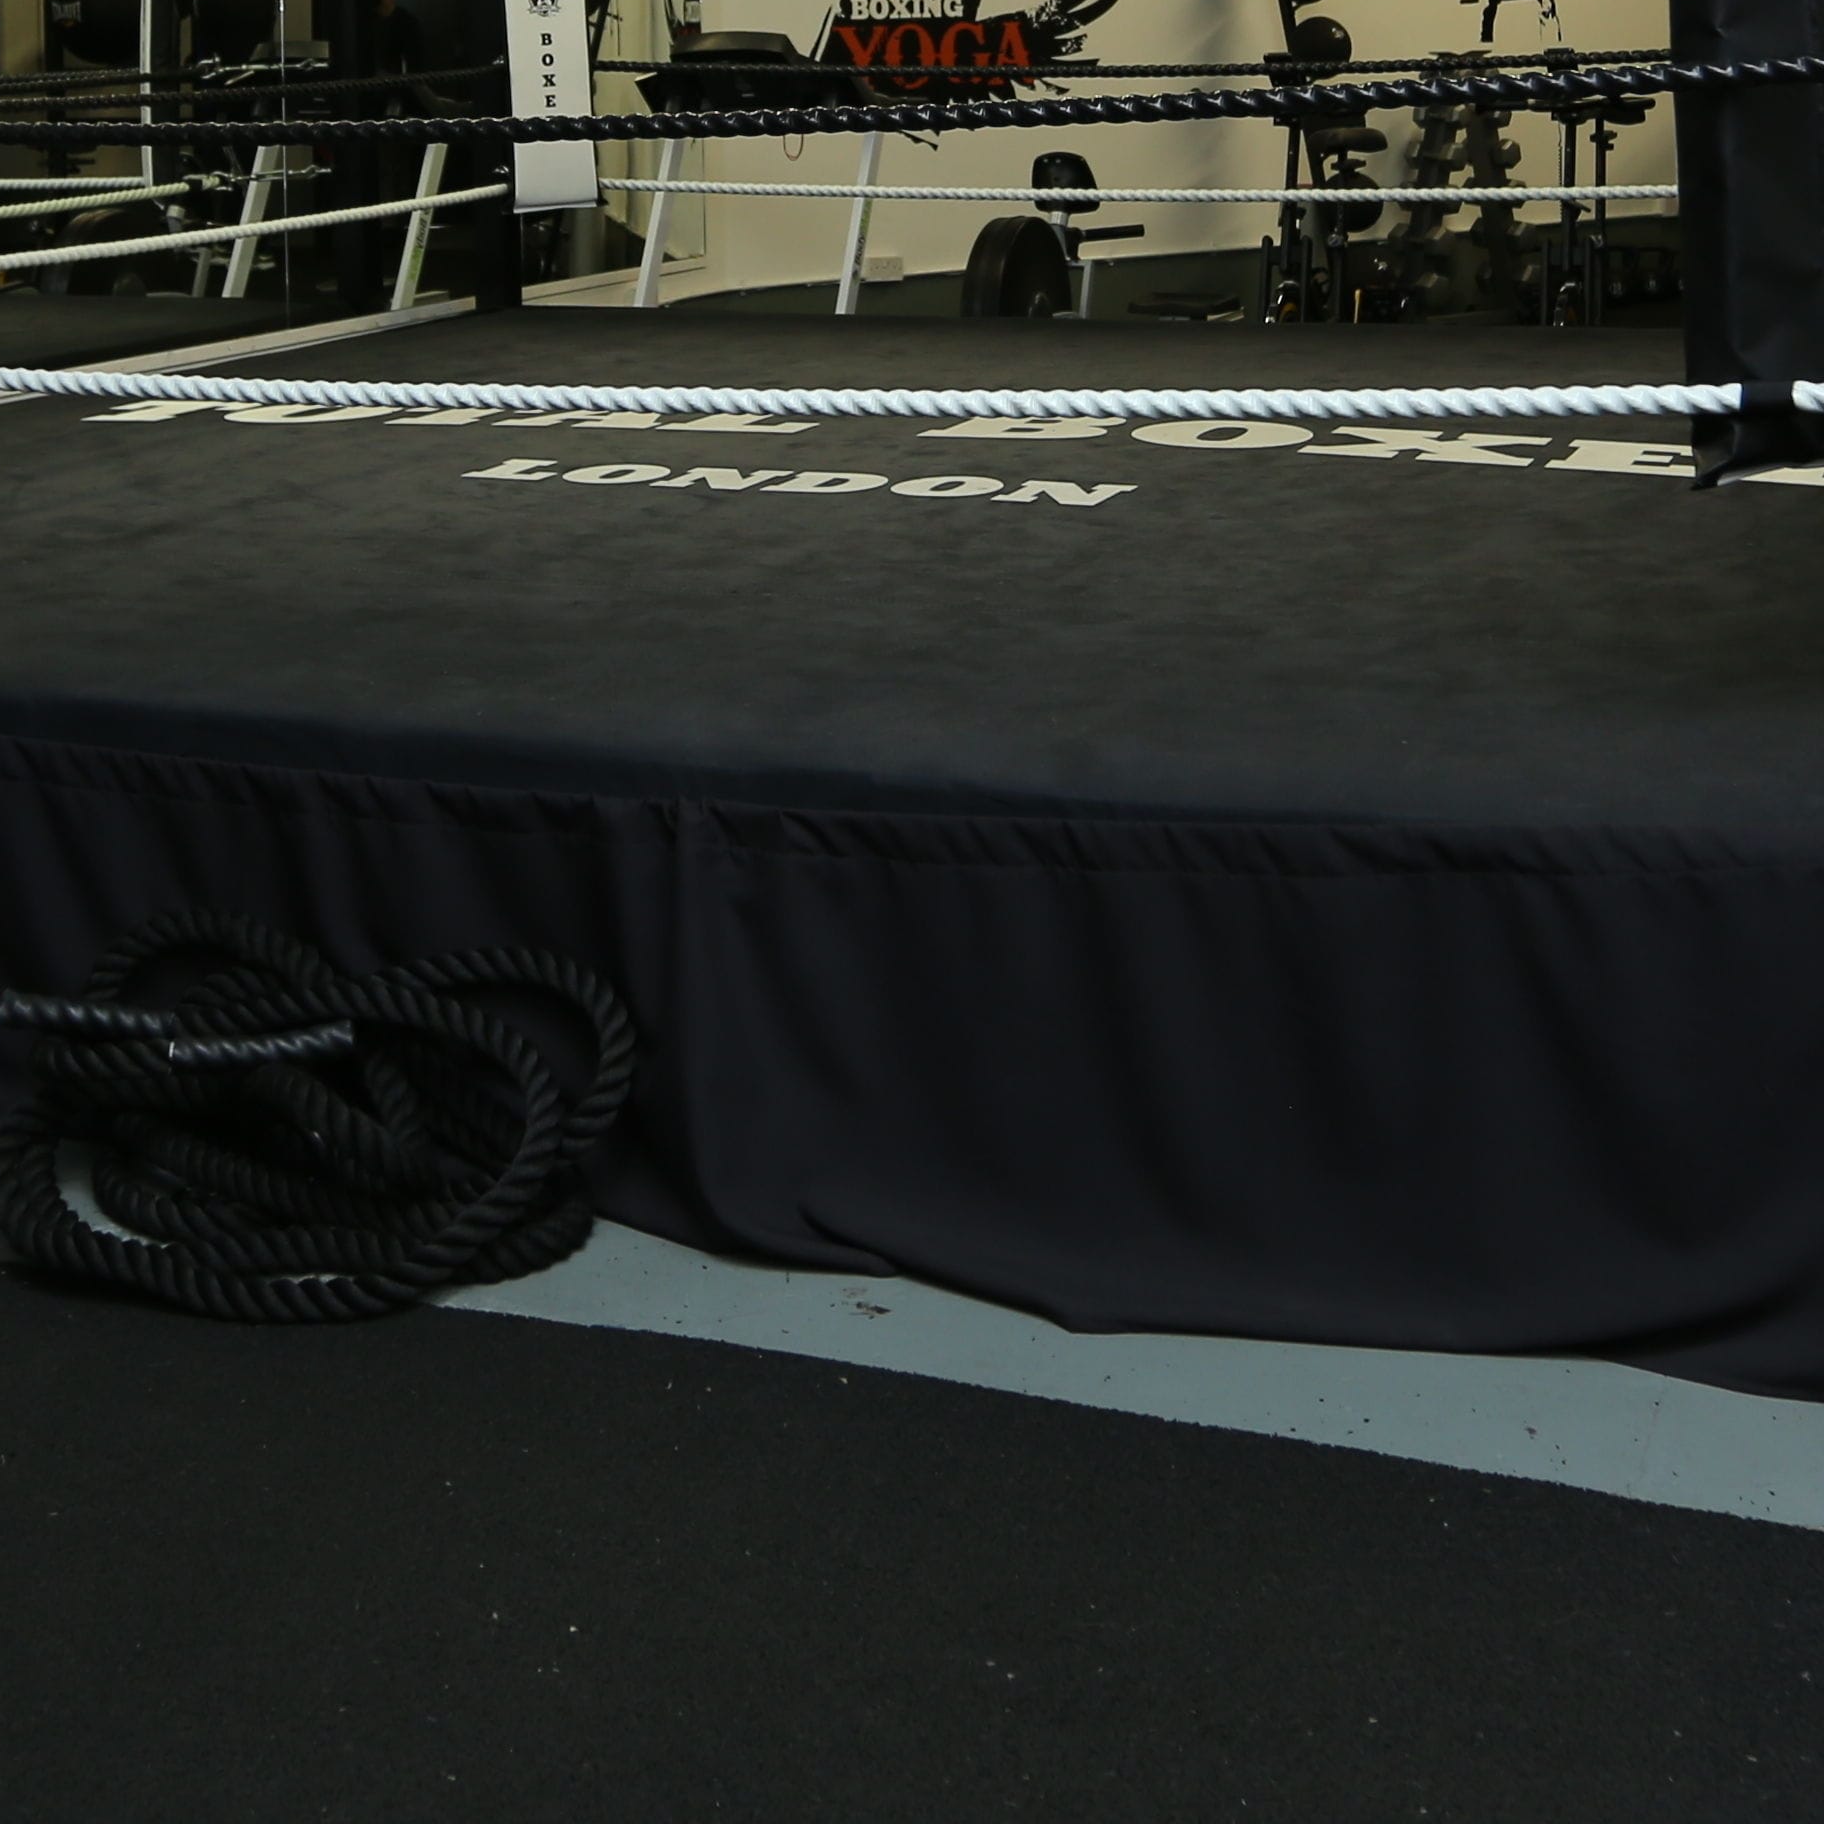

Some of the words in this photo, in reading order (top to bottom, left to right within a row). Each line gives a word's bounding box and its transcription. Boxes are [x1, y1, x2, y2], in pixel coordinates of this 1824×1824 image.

[540, 32, 557, 109] BOXE
[833, 19, 1036, 91] YOGA
[461, 457, 1138, 507] LONDON
